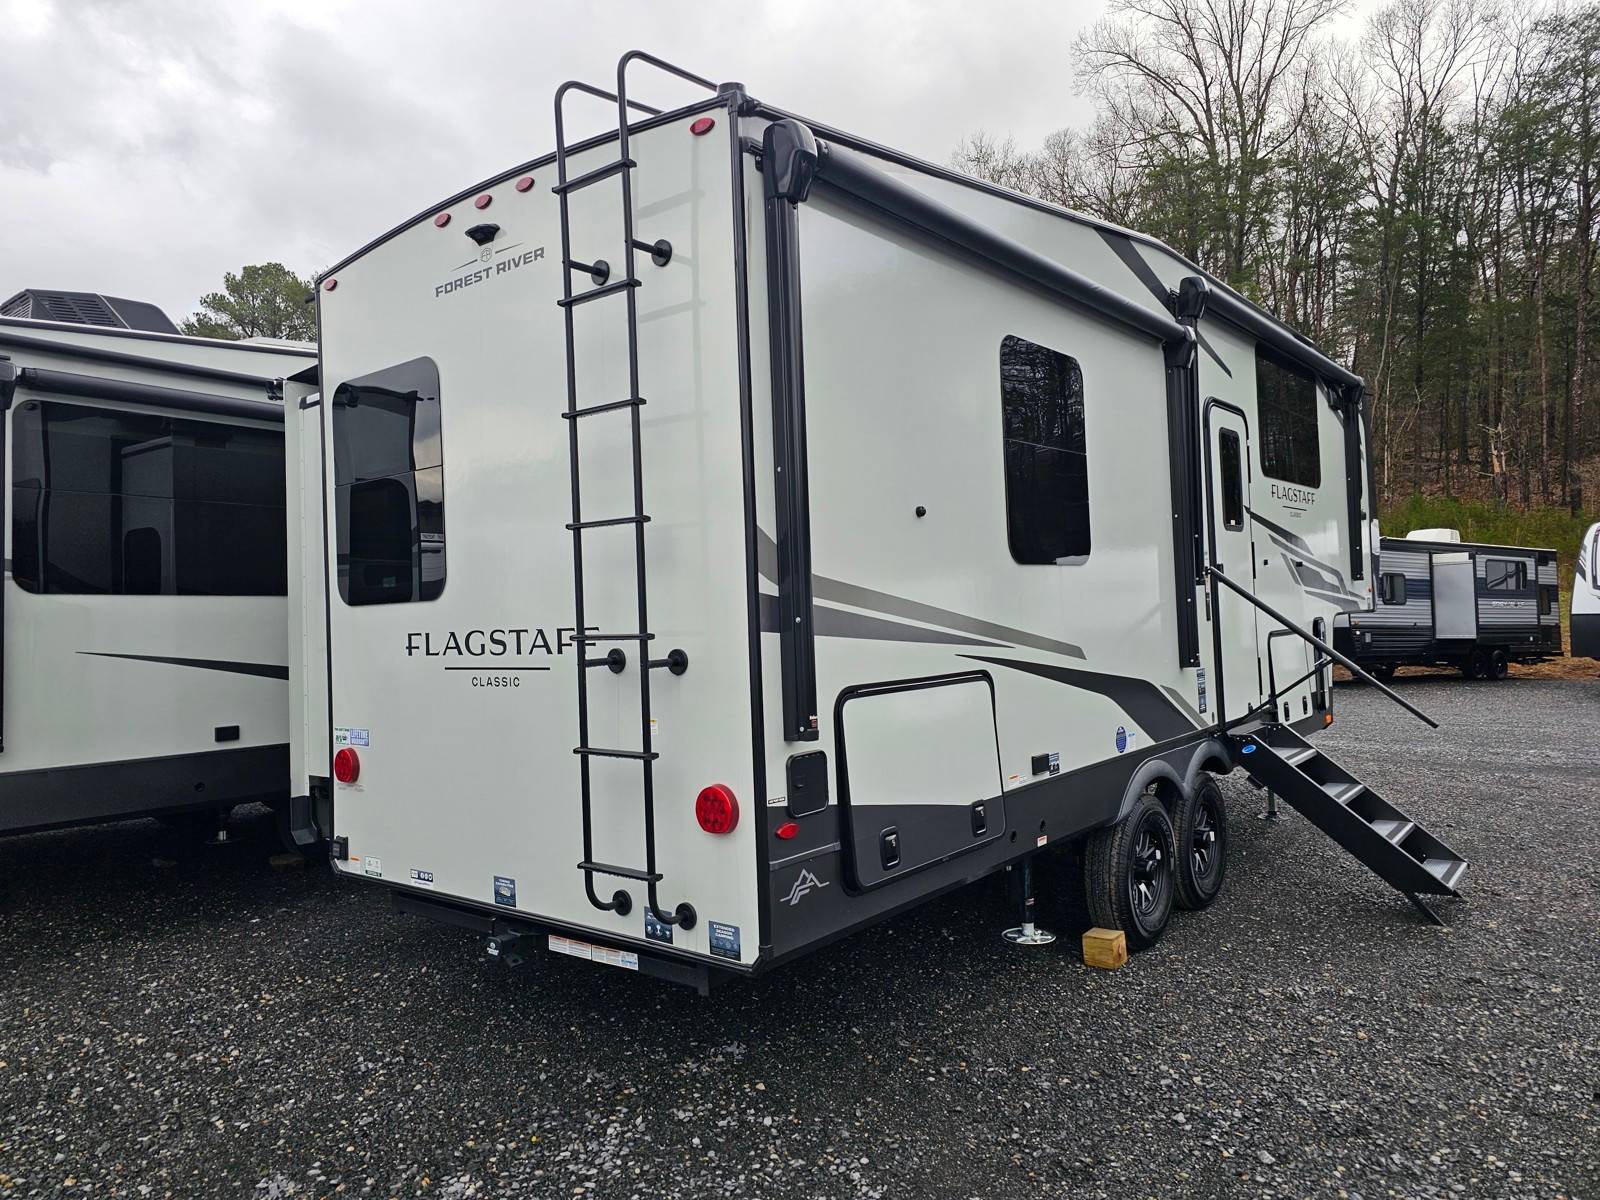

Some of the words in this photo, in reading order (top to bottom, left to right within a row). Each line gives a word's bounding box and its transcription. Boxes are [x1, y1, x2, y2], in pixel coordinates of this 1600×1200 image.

[435, 266, 492, 298] FOREST
[496, 246, 545, 275] RIVER
[1271, 484, 1315, 505] FLAGSTAFF
[471, 676, 520, 687] CLASSIC
